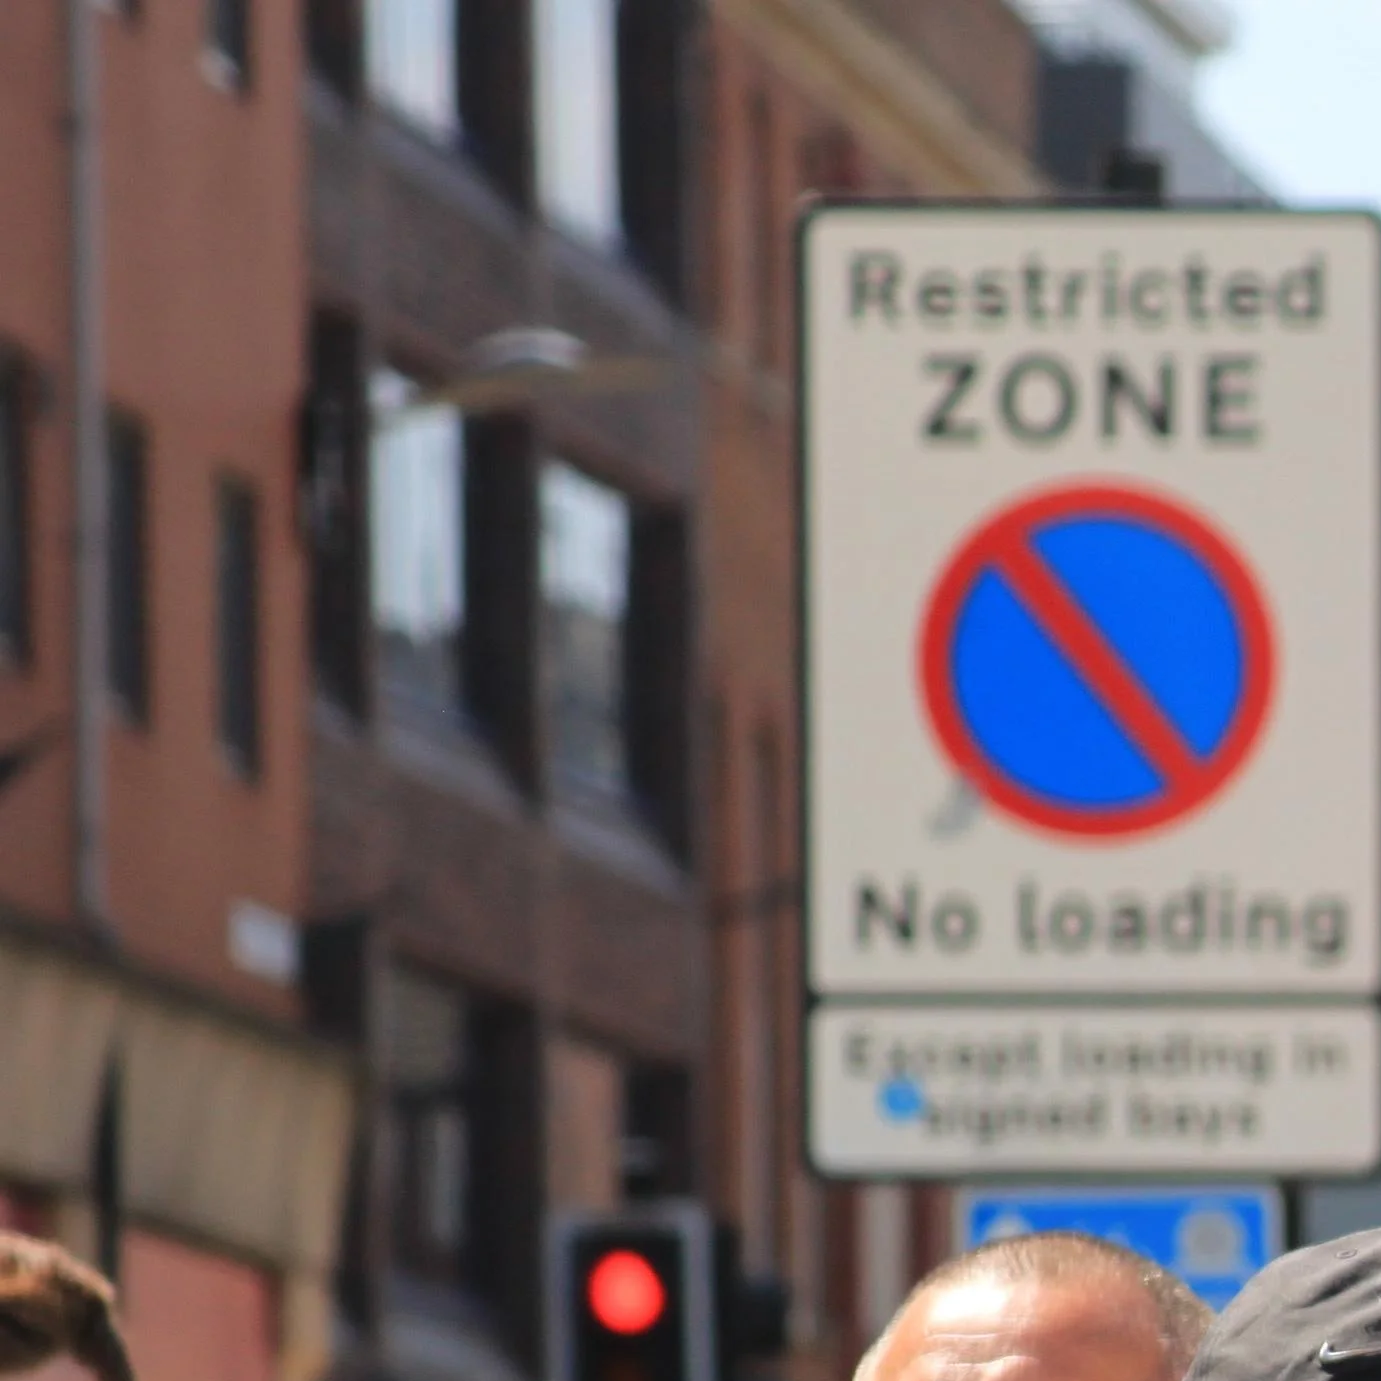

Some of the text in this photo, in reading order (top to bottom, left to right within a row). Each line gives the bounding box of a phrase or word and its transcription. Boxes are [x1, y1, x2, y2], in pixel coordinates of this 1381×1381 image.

[848, 250, 1327, 329] Restricted
[920, 351, 1265, 446] ZONE
[854, 877, 1349, 964] No loading
[1062, 1031, 1274, 1083] loading
